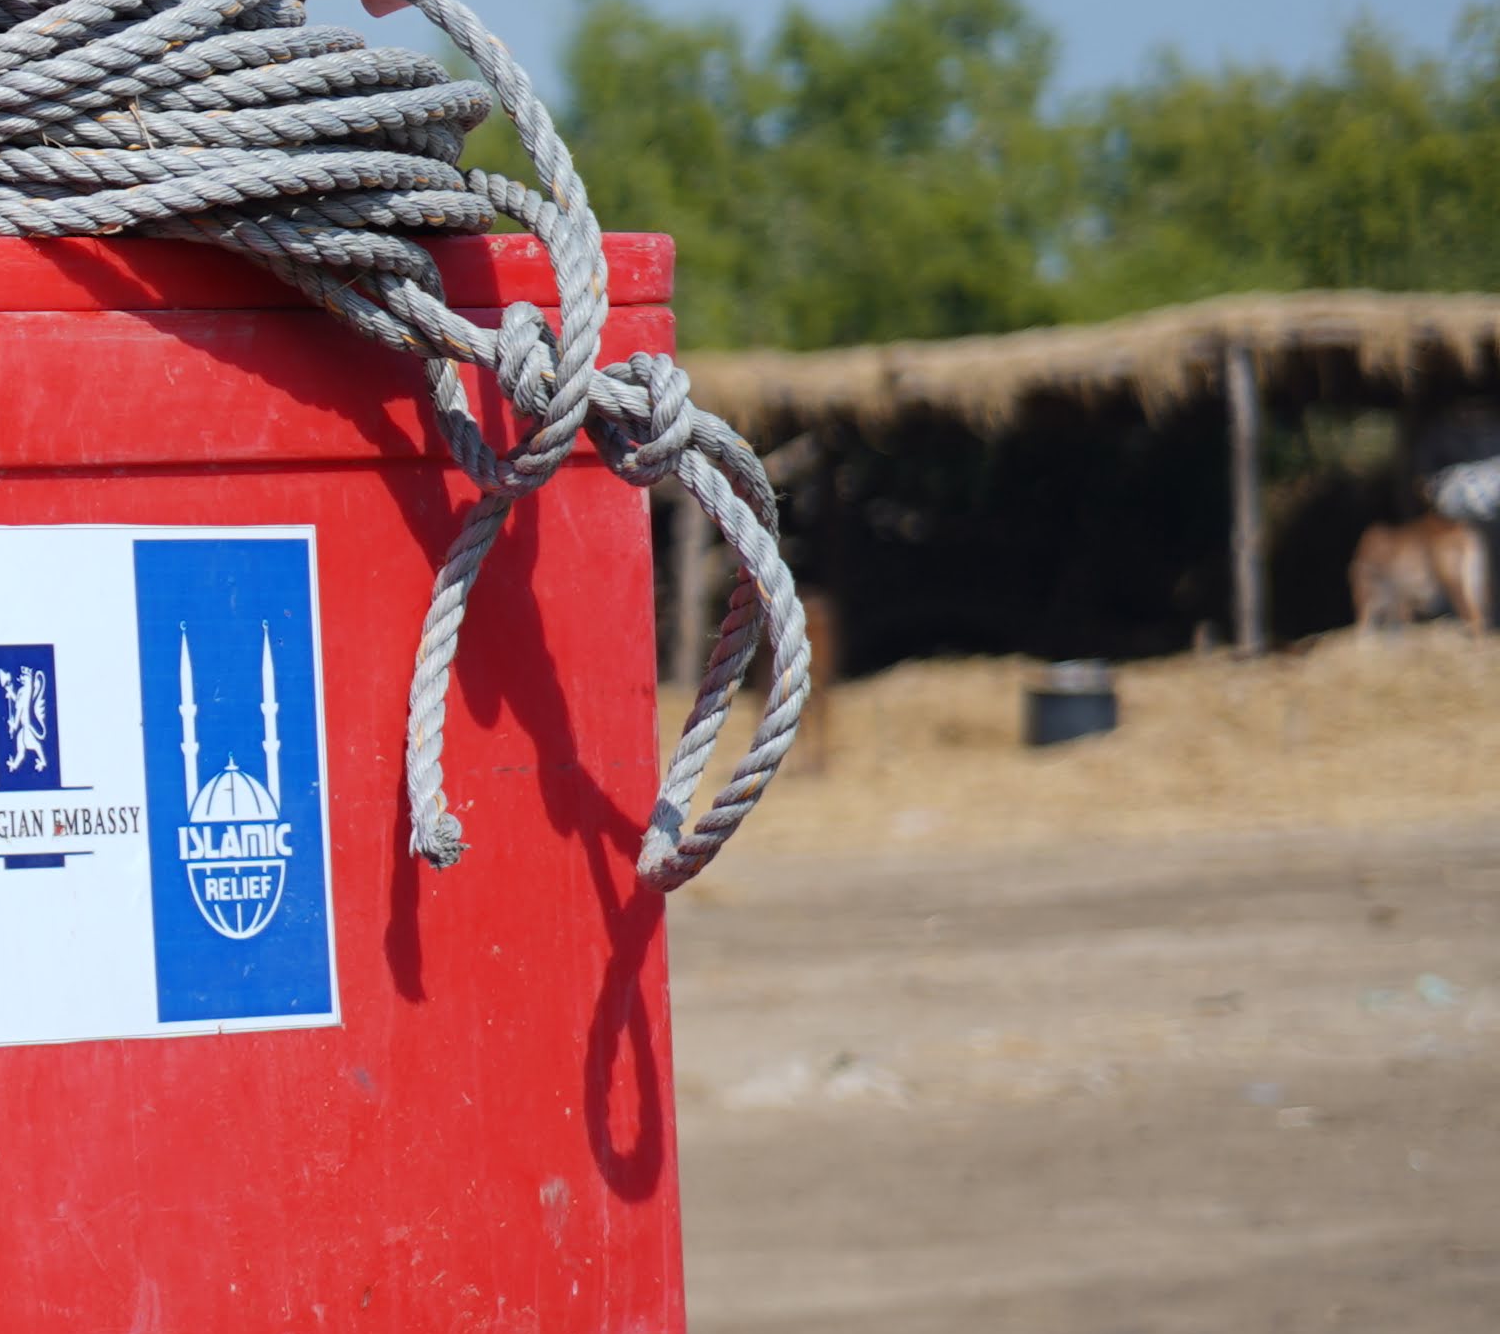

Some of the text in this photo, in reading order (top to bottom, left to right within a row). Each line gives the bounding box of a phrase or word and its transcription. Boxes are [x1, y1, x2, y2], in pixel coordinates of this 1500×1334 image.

[52, 806, 141, 838] EMBASSY
[177, 822, 293, 860] ISLAMIC
[204, 875, 272, 902] RELIEF
